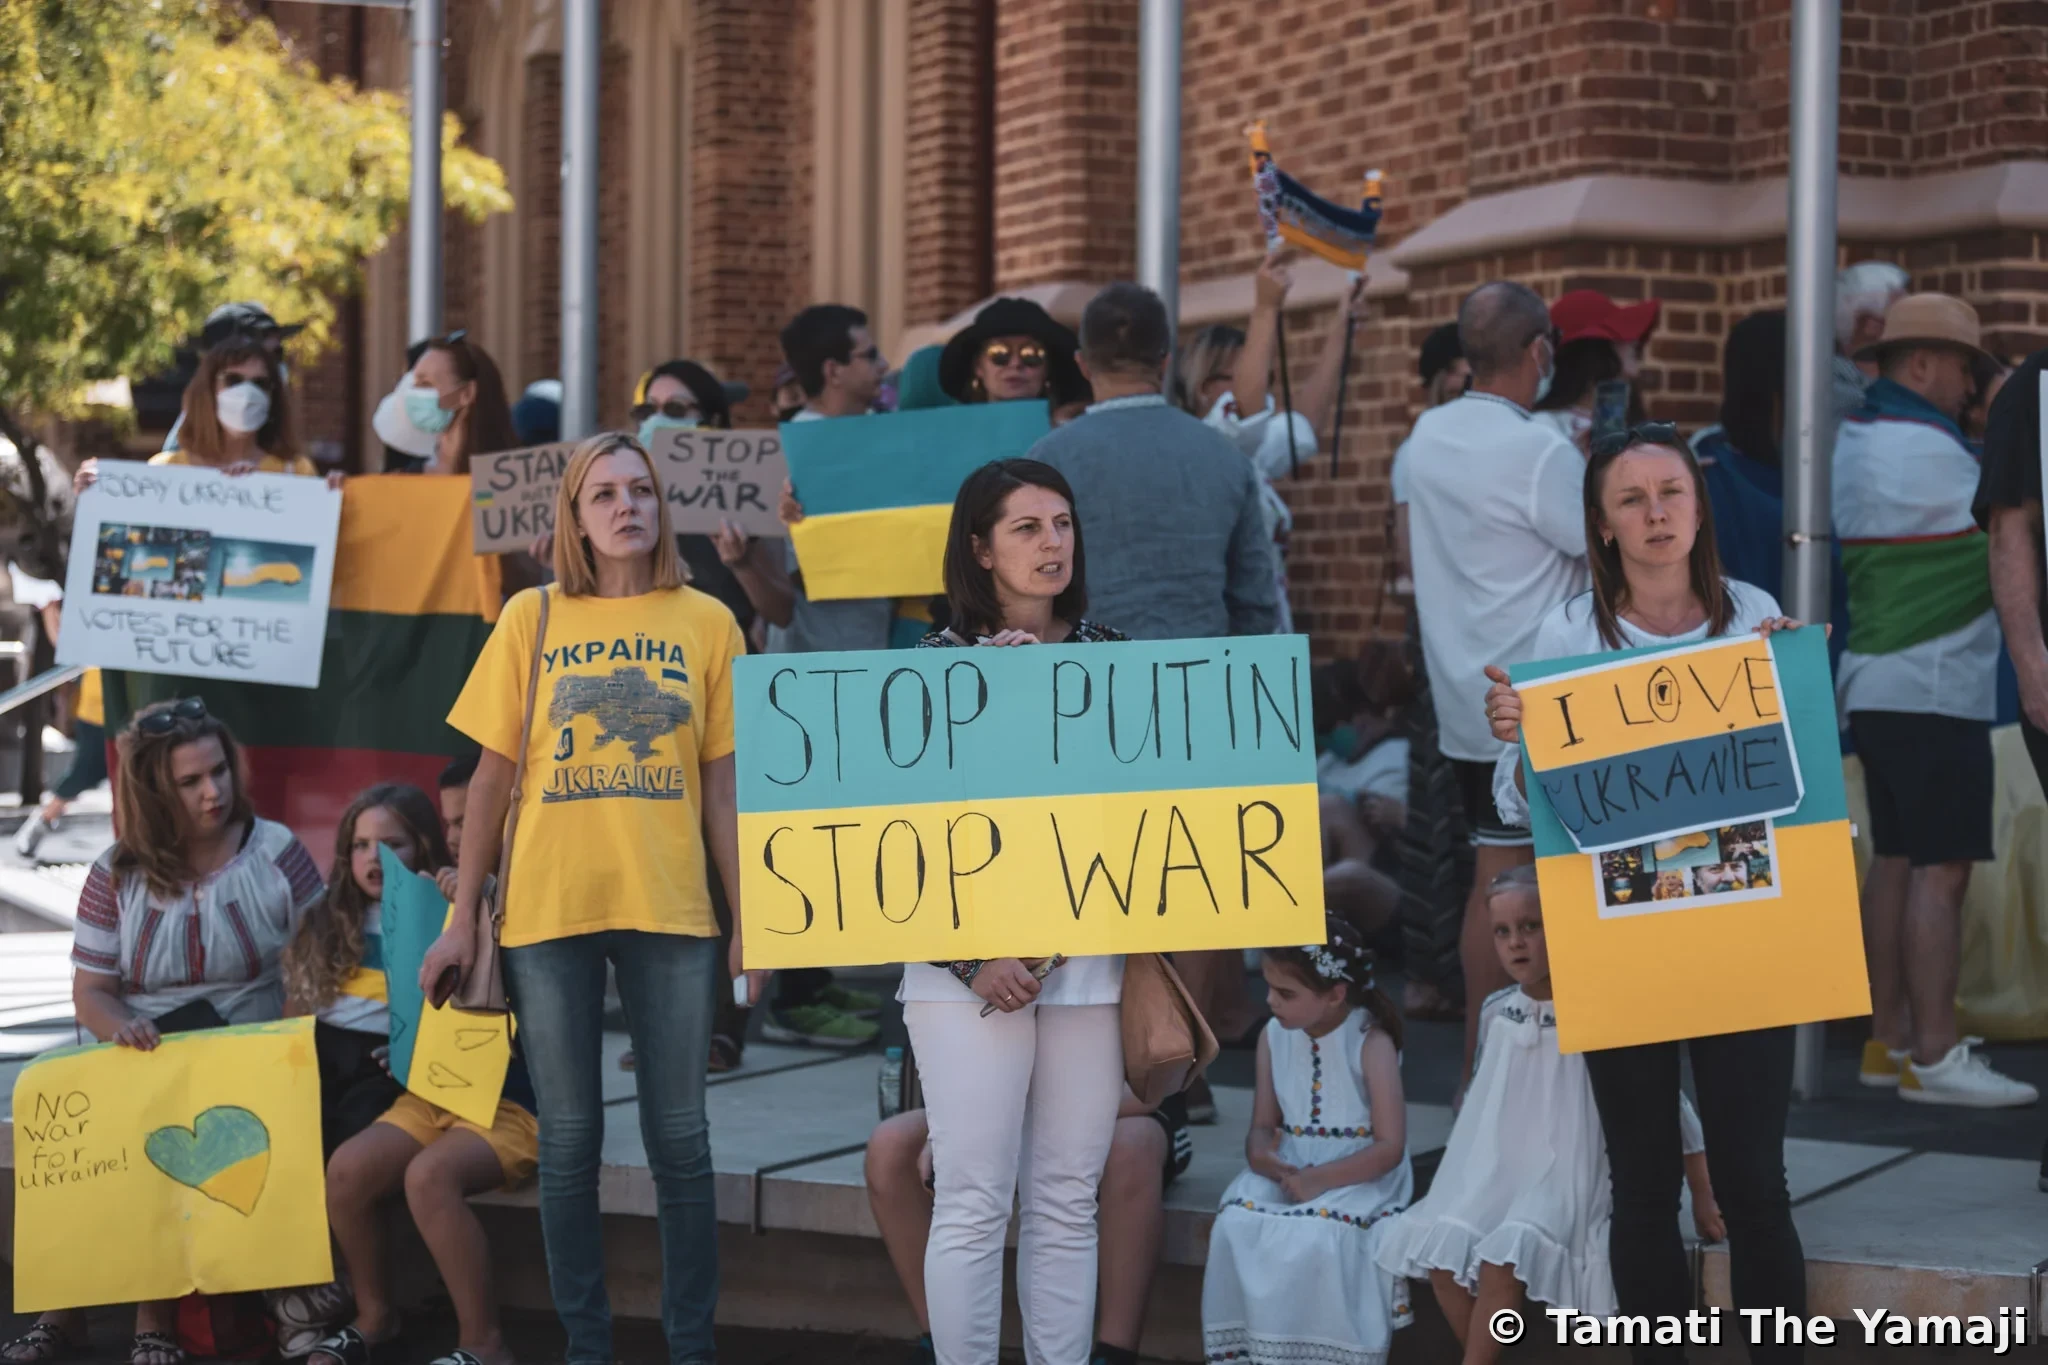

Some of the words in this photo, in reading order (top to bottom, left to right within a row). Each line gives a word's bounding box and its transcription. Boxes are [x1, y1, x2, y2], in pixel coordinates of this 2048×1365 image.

[667, 432, 778, 464] STOP
[489, 449, 568, 492] STAN
[701, 468, 740, 481] THE
[178, 480, 284, 514] UKRAINE
[666, 482, 769, 512] WAR
[482, 503, 556, 541] UKR
[79, 607, 168, 637] VOTES
[175, 612, 222, 641] FOR
[232, 616, 293, 645] THE
[133, 637, 256, 669] FUTURE
[543, 633, 686, 673] УКРАЇНА
[1553, 692, 1584, 749] I
[1614, 657, 1778, 726] LOVE
[764, 660, 989, 786] STOP
[763, 811, 1002, 936] STOP
[1050, 800, 1299, 920] WAR
[35, 1091, 91, 1122] NO
[32, 1145, 88, 1169] for
